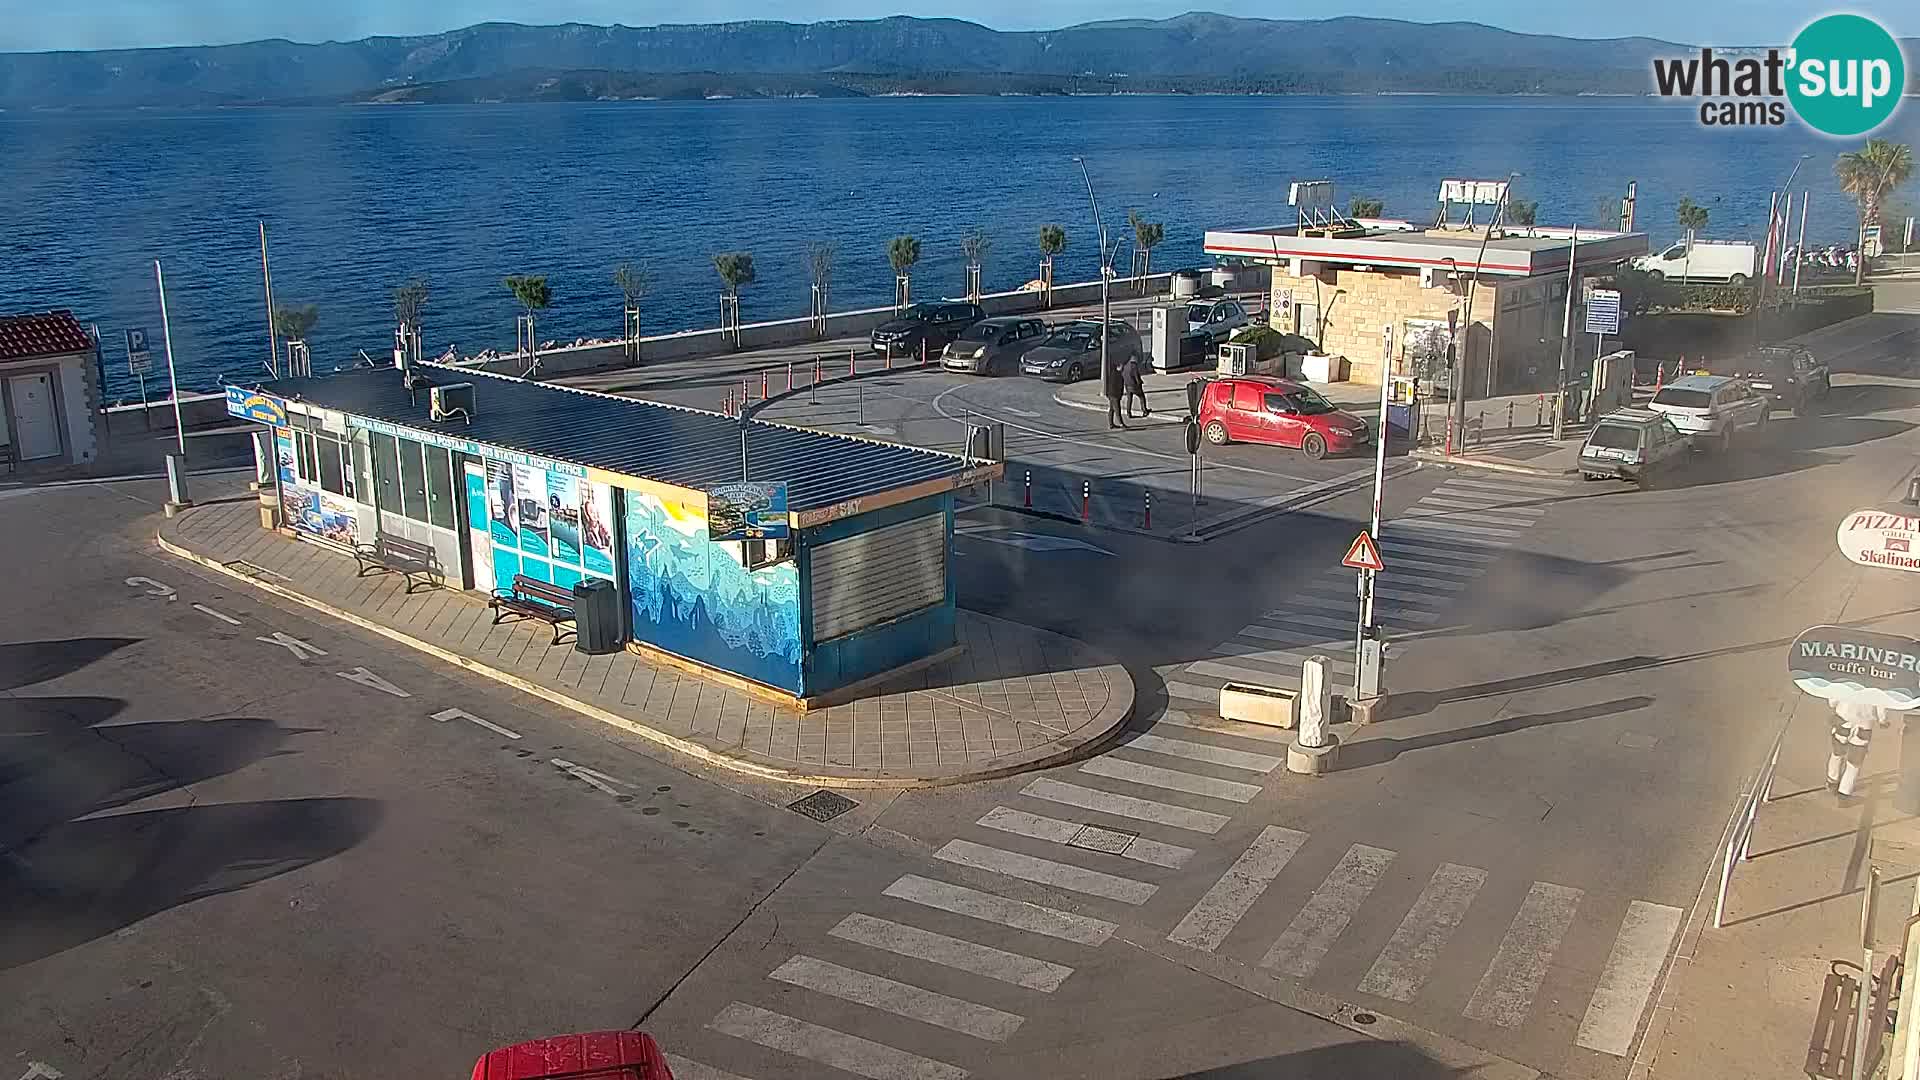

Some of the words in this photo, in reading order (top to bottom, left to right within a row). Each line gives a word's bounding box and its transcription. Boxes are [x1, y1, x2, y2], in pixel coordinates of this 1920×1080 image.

[494, 447, 526, 464] STATION
[528, 455, 555, 470] TICKET
[556, 461, 583, 477] OFFICE
[1850, 515, 1920, 533] PIZZE
[1829, 660, 1866, 676] caffe
[1870, 665, 1897, 680] bar
